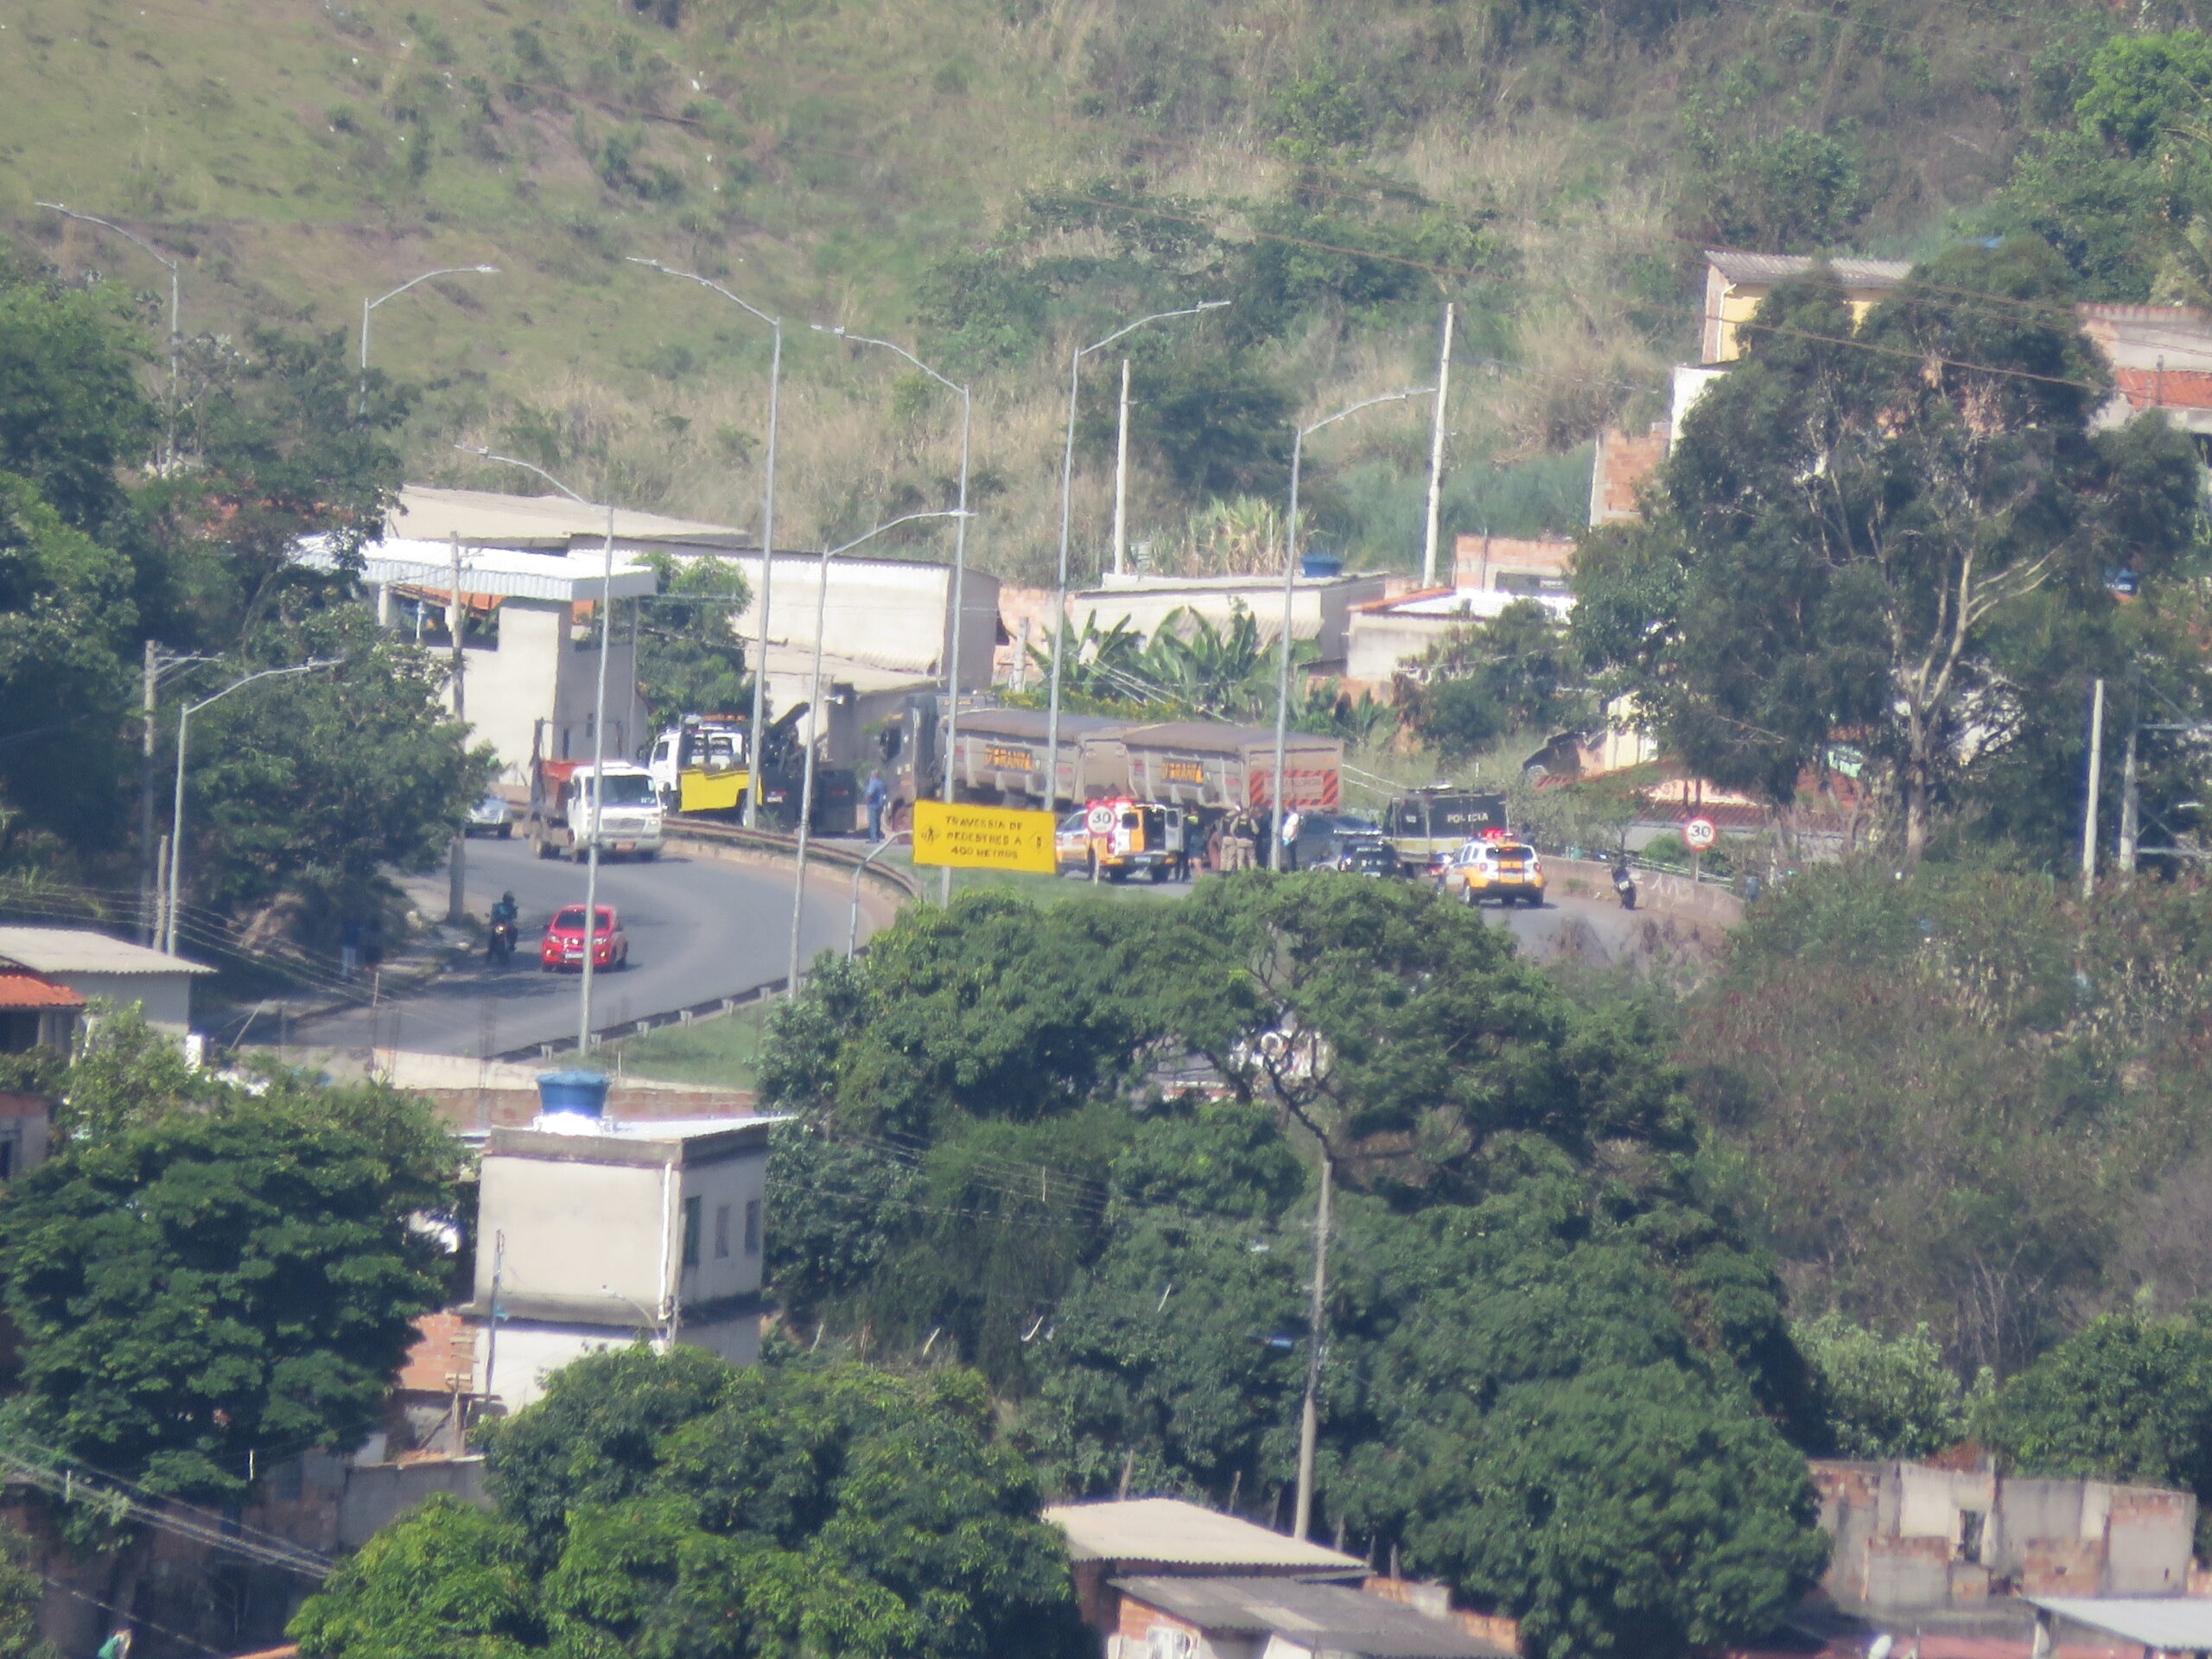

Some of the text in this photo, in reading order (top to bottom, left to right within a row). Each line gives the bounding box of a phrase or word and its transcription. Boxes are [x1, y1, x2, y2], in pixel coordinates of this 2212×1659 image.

[1092, 812, 1111, 823] 30
[1691, 825, 1711, 837] 30
[1014, 836, 1023, 845] A
[951, 846, 974, 855] 400
